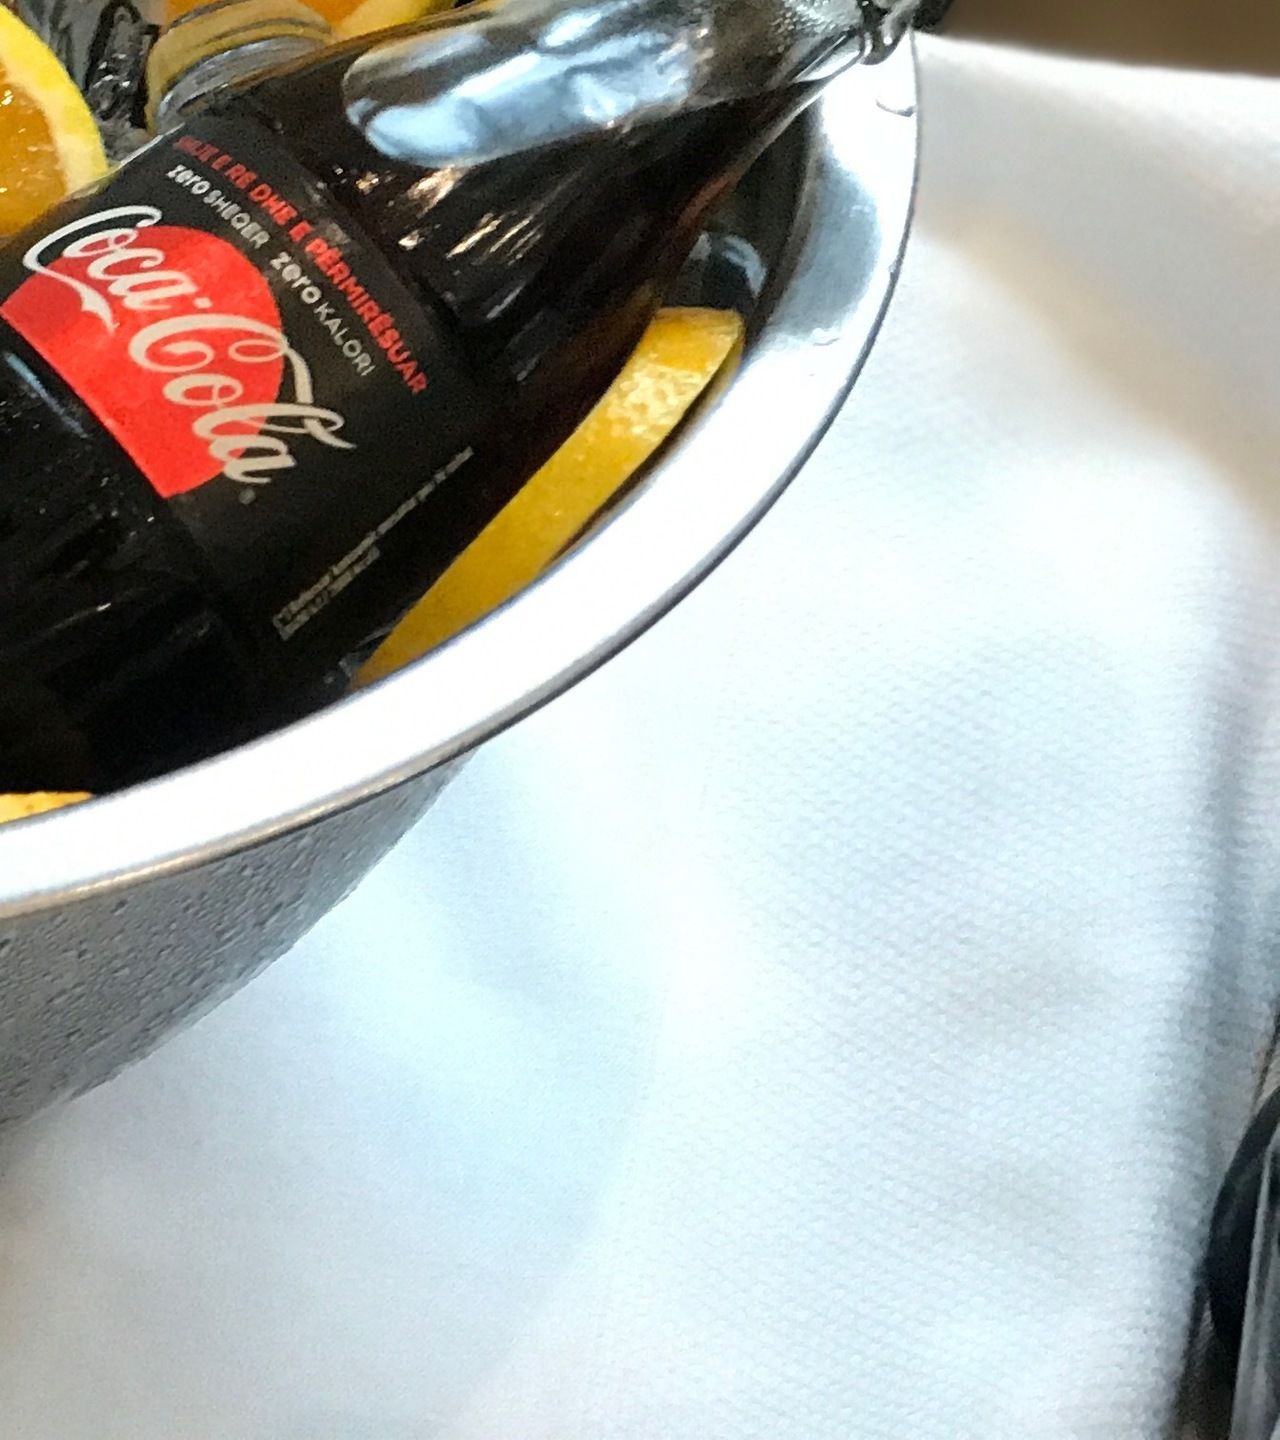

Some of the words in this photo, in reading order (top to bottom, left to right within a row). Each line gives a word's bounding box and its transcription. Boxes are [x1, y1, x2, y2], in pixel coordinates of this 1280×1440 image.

[165, 164, 211, 195] zero
[202, 188, 271, 249] SHEQER
[269, 251, 323, 305] zero
[313, 301, 376, 377] KALORI
[224, 162, 258, 190] RE
[249, 182, 299, 227] DHE
[288, 219, 315, 243] E
[23, 205, 356, 484] Coca-Cola
